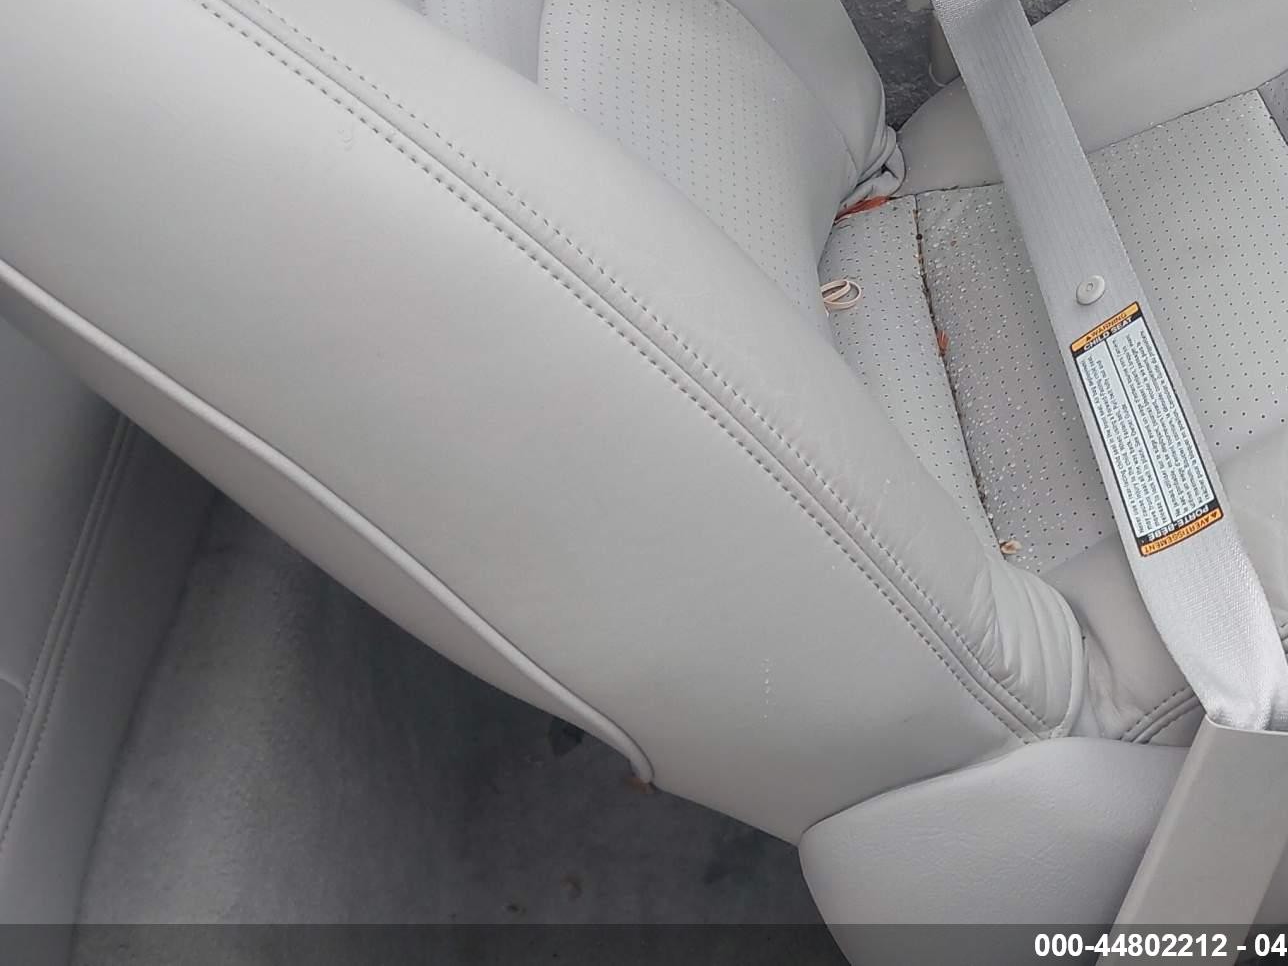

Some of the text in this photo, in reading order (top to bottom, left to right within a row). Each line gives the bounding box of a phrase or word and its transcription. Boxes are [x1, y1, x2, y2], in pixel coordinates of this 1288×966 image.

[1083, 315, 1134, 351] CHILD SEAT
[1090, 313, 1128, 340] WARNING
[1143, 515, 1211, 553] AVERTISSEMENT
